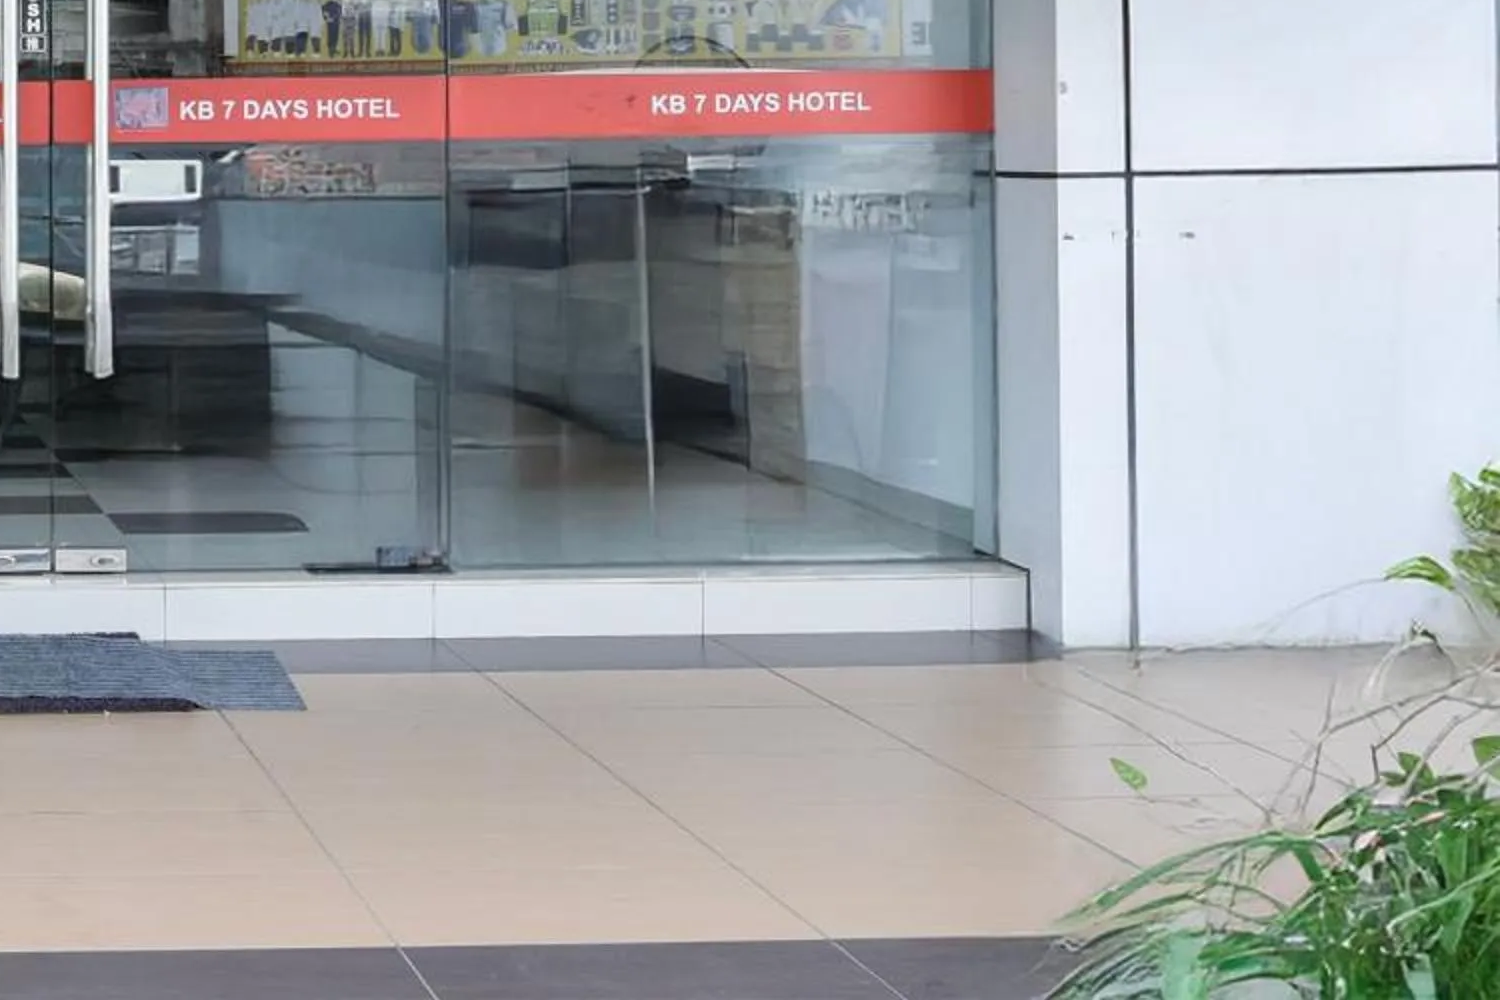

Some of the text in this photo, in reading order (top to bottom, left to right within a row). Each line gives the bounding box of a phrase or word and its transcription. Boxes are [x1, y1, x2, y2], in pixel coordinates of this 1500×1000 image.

[179, 98, 400, 121] KB 7 DAYS HOTEL
[651, 91, 871, 115] KB 7 DAYS HOTEL
